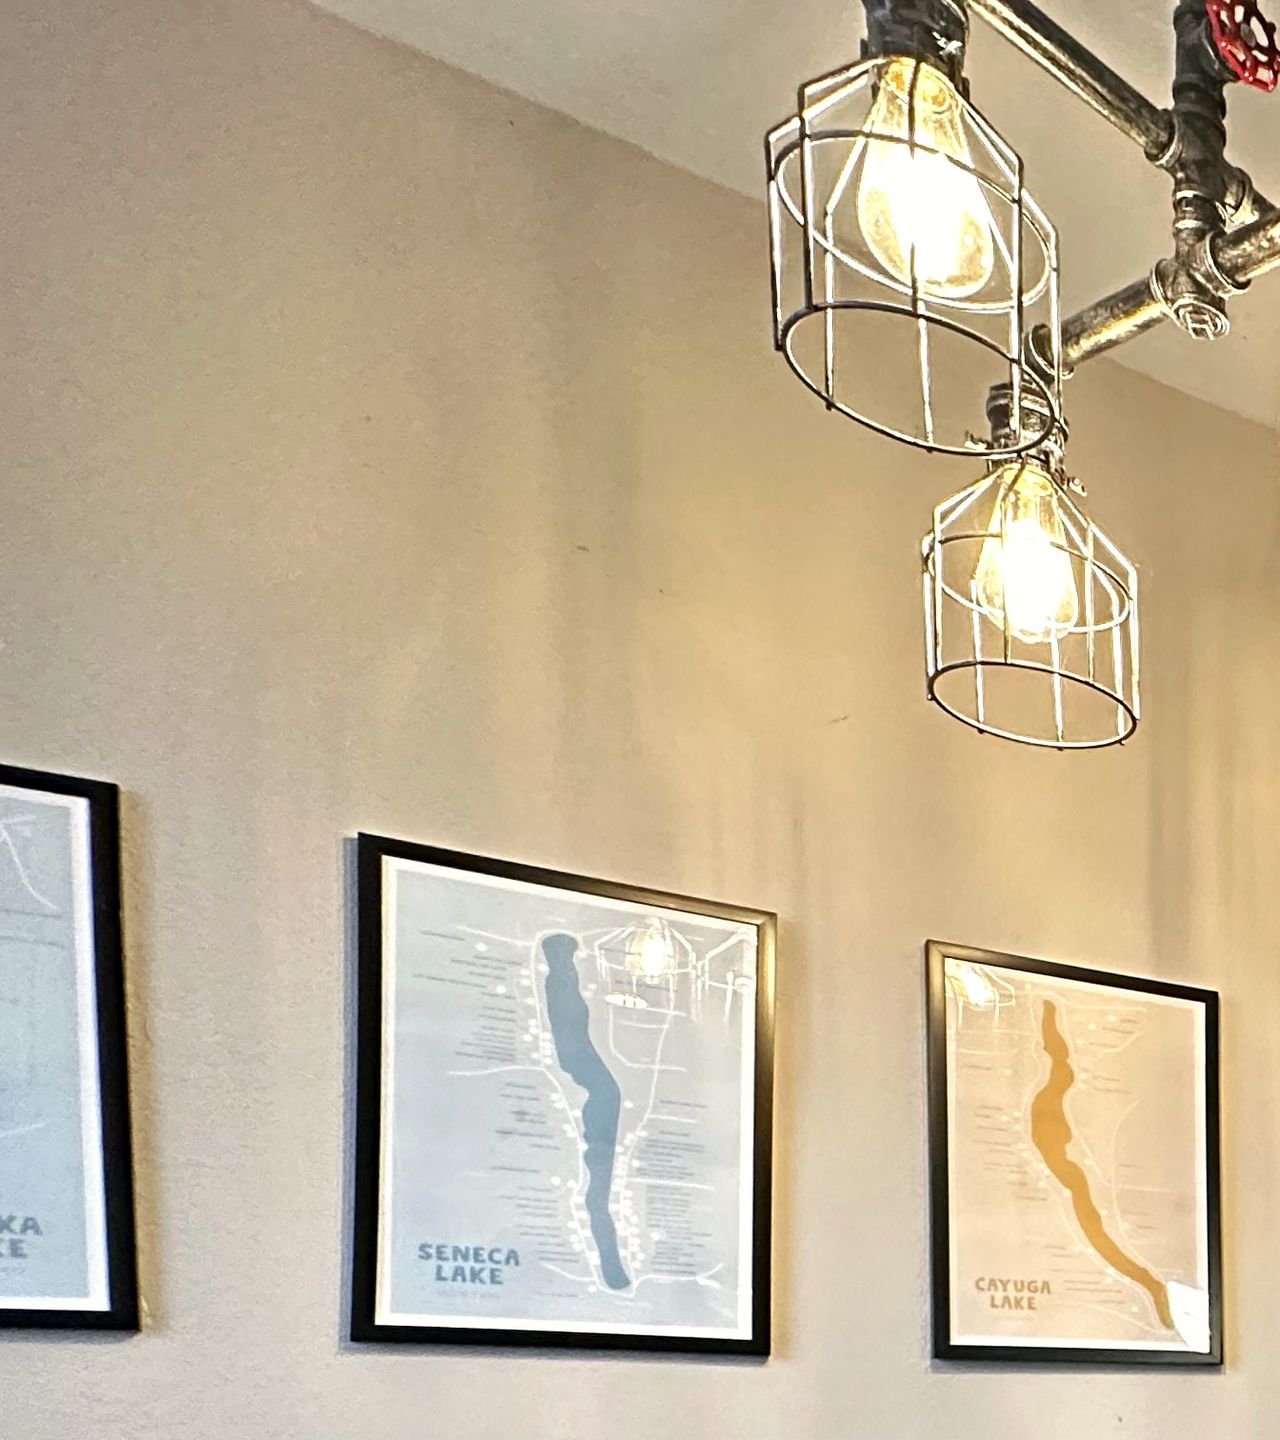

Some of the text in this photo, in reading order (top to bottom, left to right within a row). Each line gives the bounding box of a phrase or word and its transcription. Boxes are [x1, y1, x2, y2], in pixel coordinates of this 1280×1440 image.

[418, 1242, 520, 1266] SENECA
[435, 1265, 504, 1285] LAKE
[975, 1276, 1051, 1295] CAYUGA
[990, 1294, 1037, 1310] LAKE
